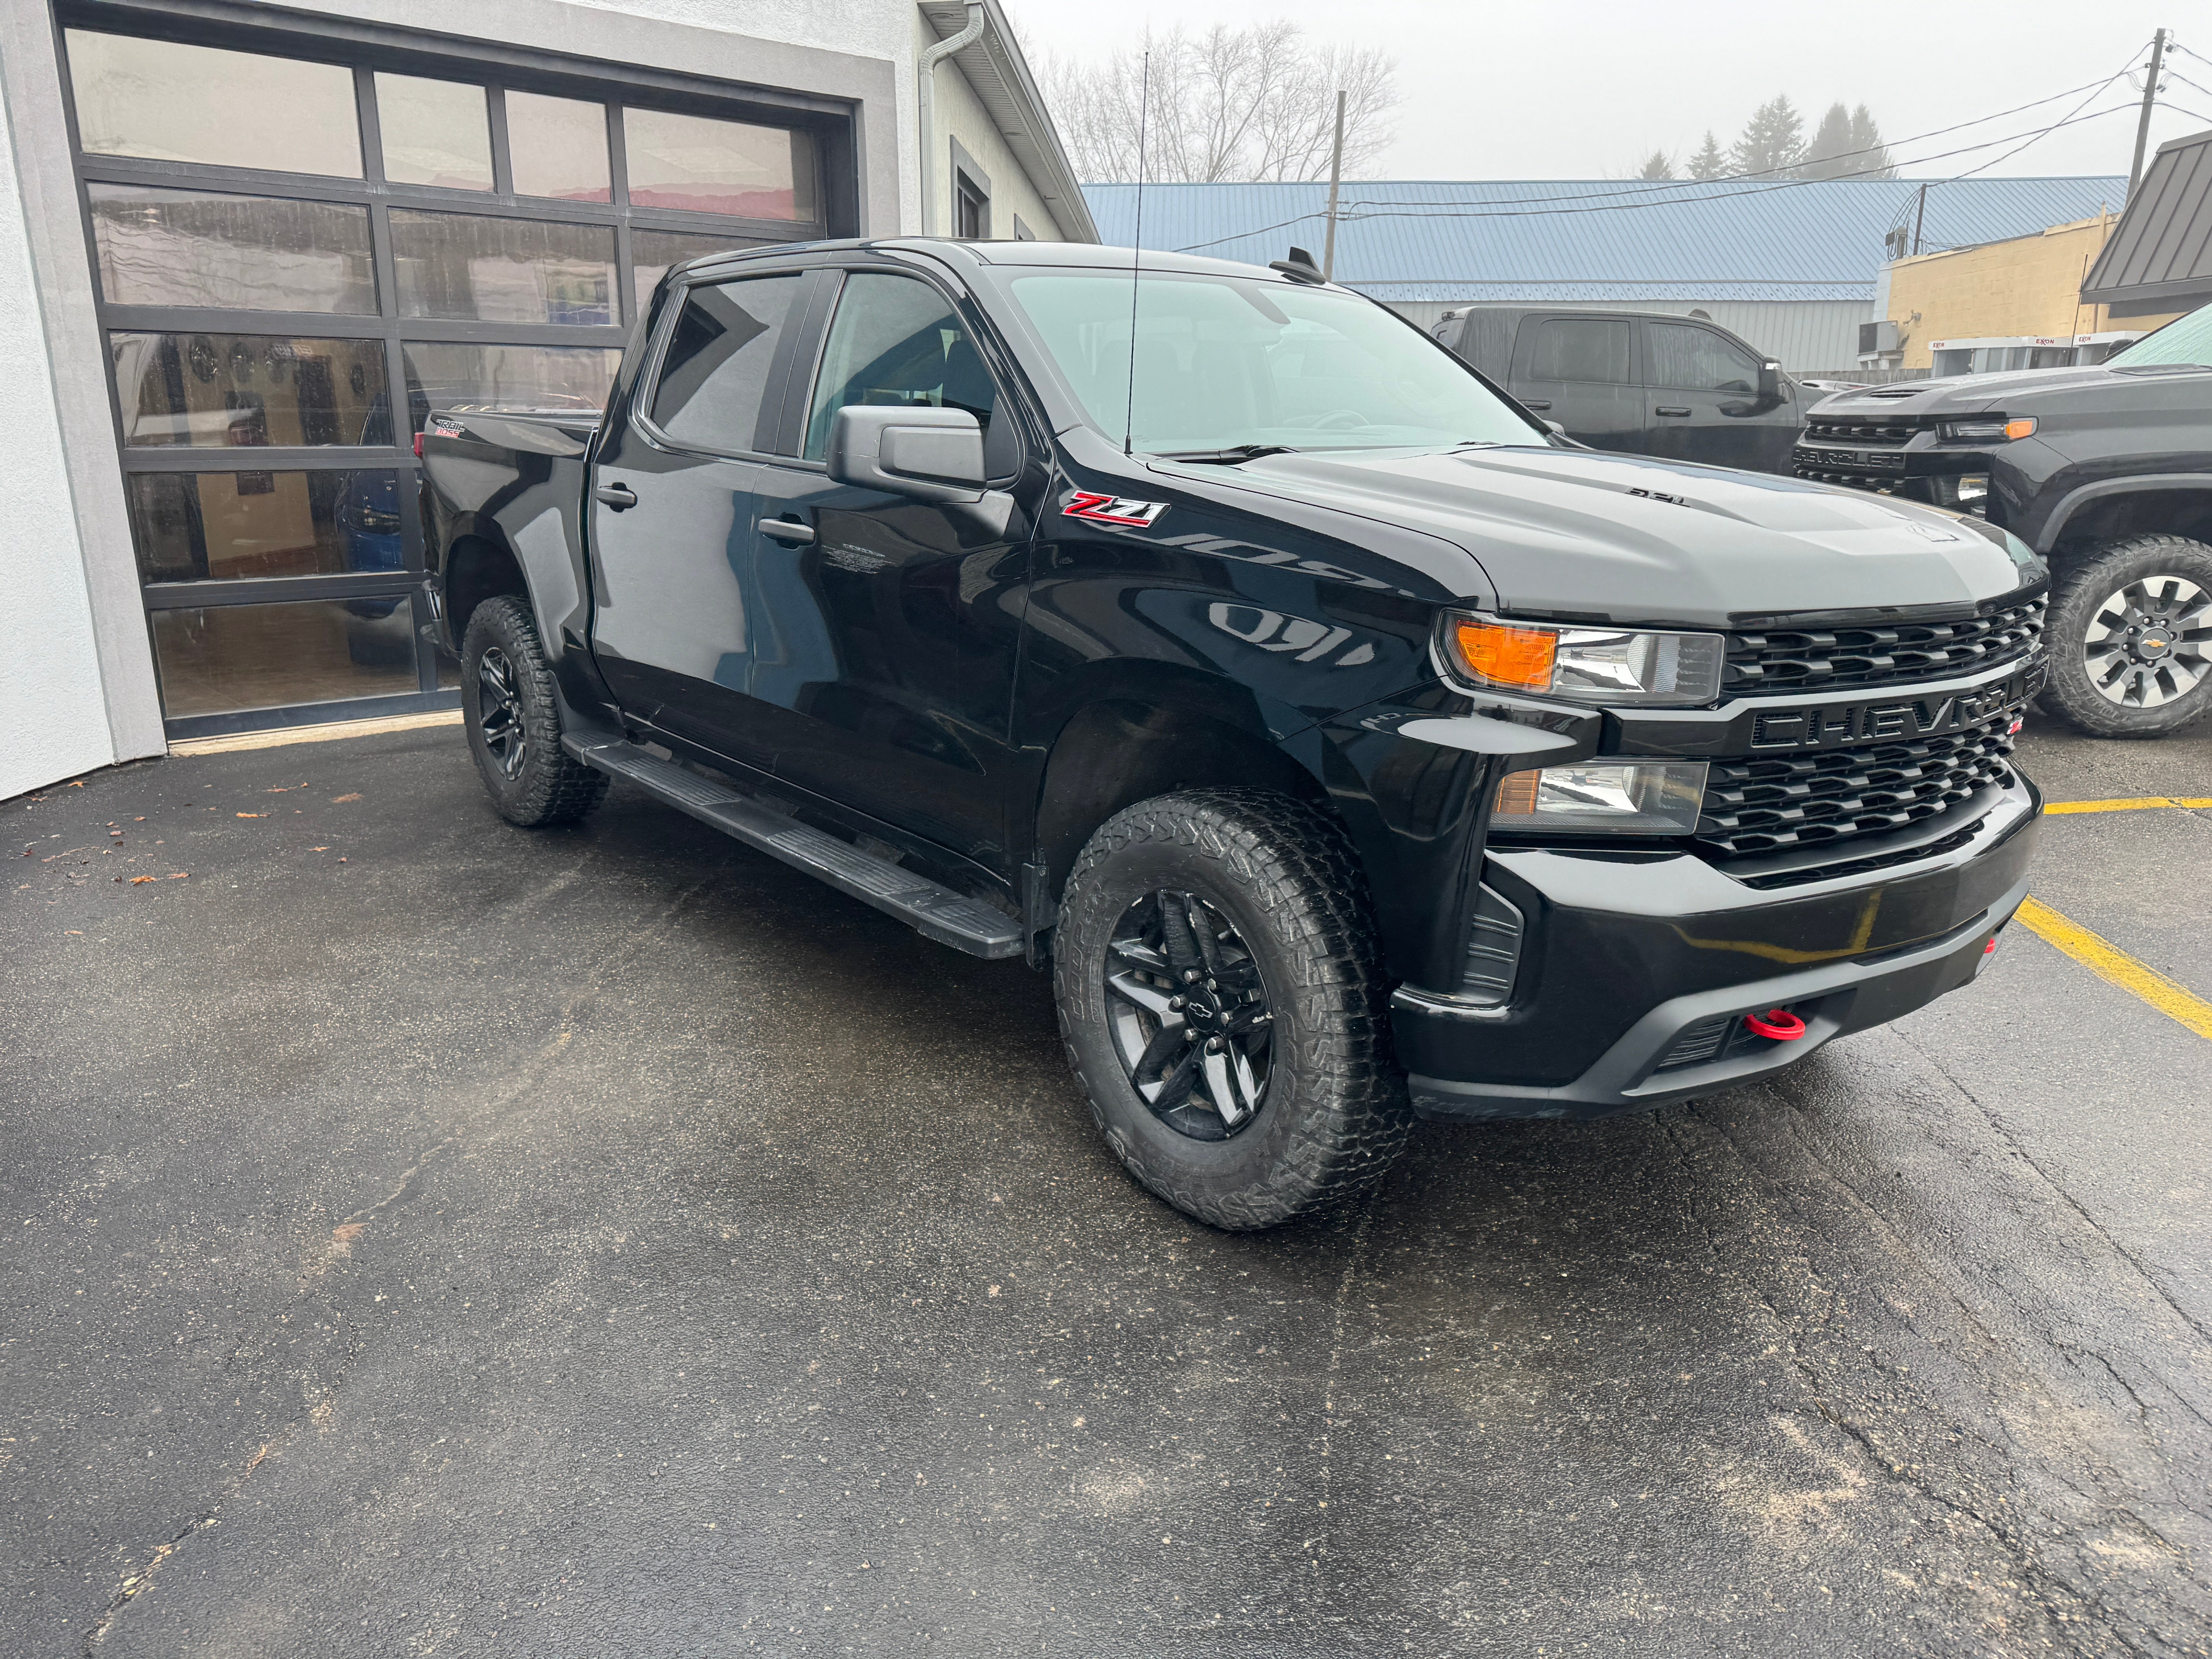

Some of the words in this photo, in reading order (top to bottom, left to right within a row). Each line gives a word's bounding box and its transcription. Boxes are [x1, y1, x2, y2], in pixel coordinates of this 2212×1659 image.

[436, 419, 465, 432] TRAIL
[436, 428, 459, 437] BOSS
[1793, 449, 1901, 468] CHEVROLET
[1060, 490, 1171, 529] Z71
